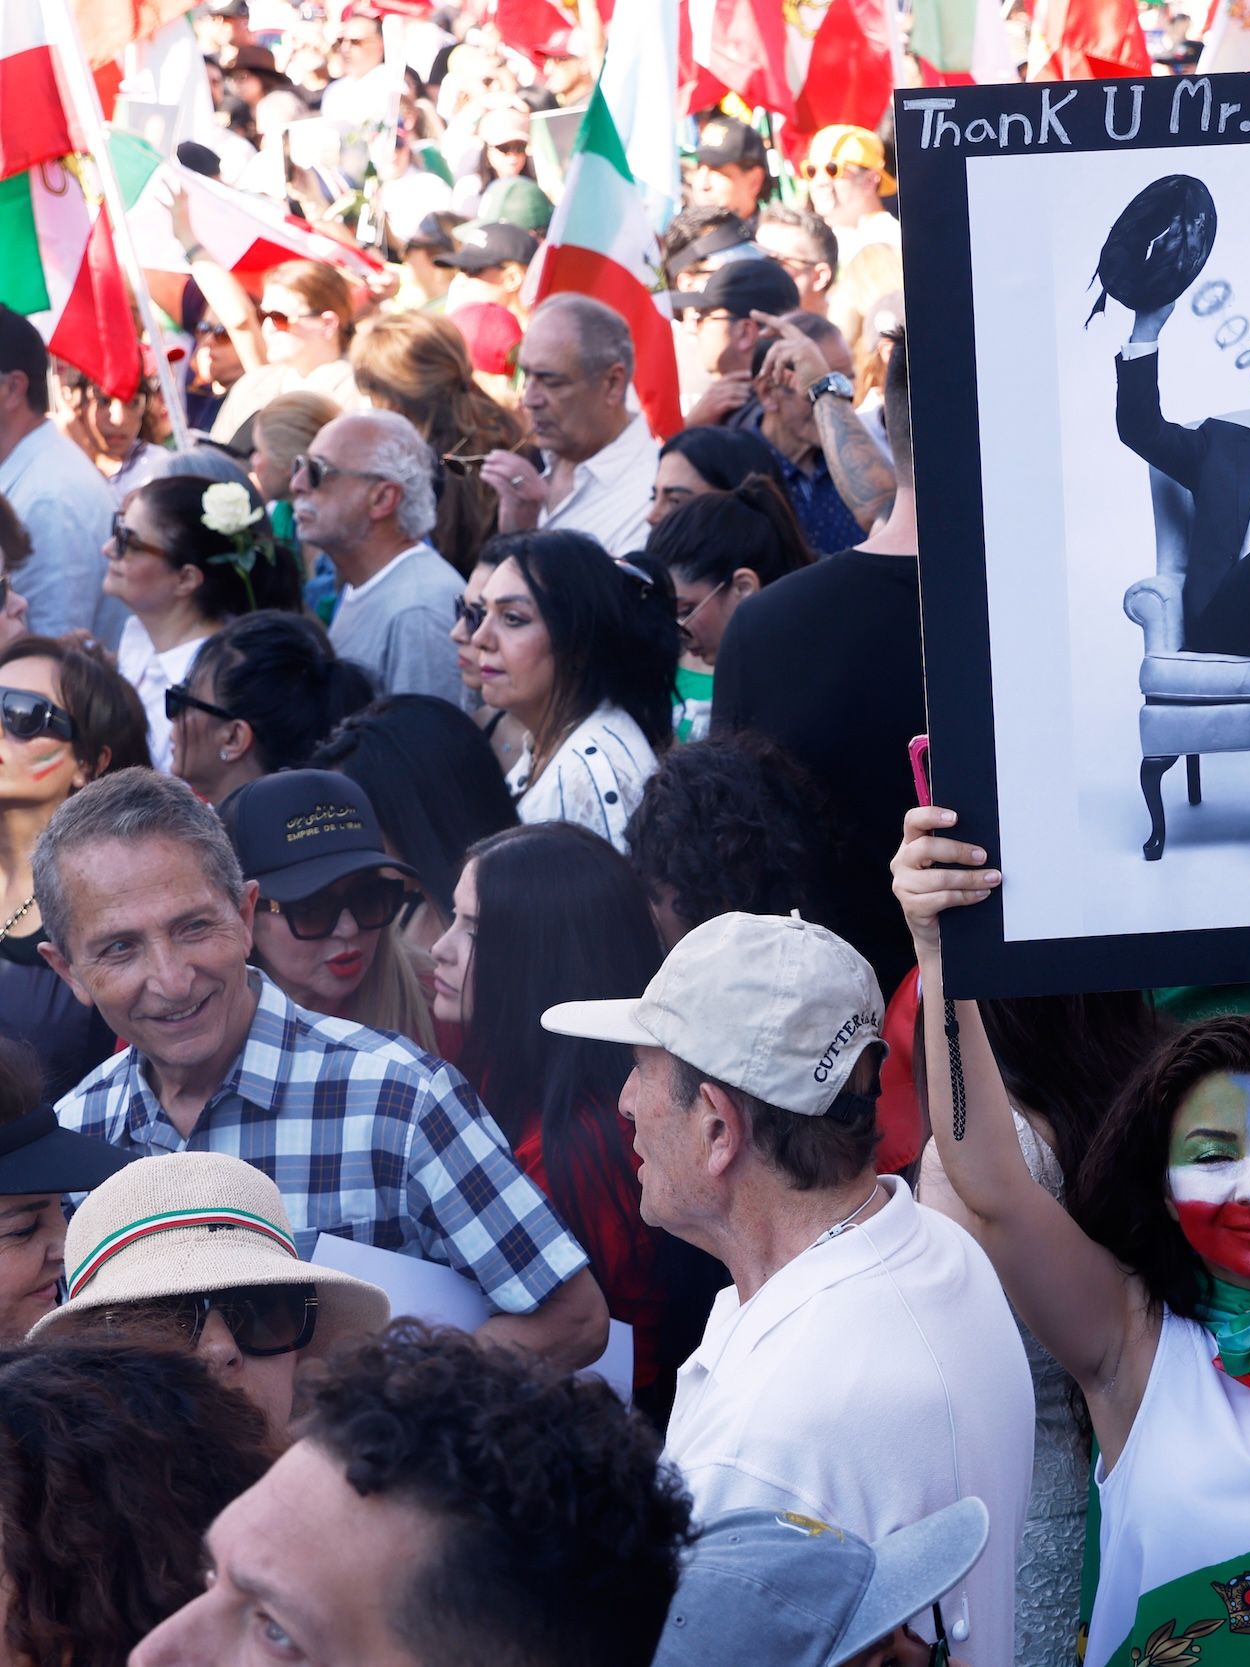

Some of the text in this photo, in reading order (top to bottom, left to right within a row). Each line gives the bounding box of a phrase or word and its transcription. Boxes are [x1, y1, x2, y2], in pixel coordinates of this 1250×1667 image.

[1103, 84, 1145, 141] U
[287, 826, 321, 842] EMPIRE
[814, 1014, 863, 1083] CUTTER
